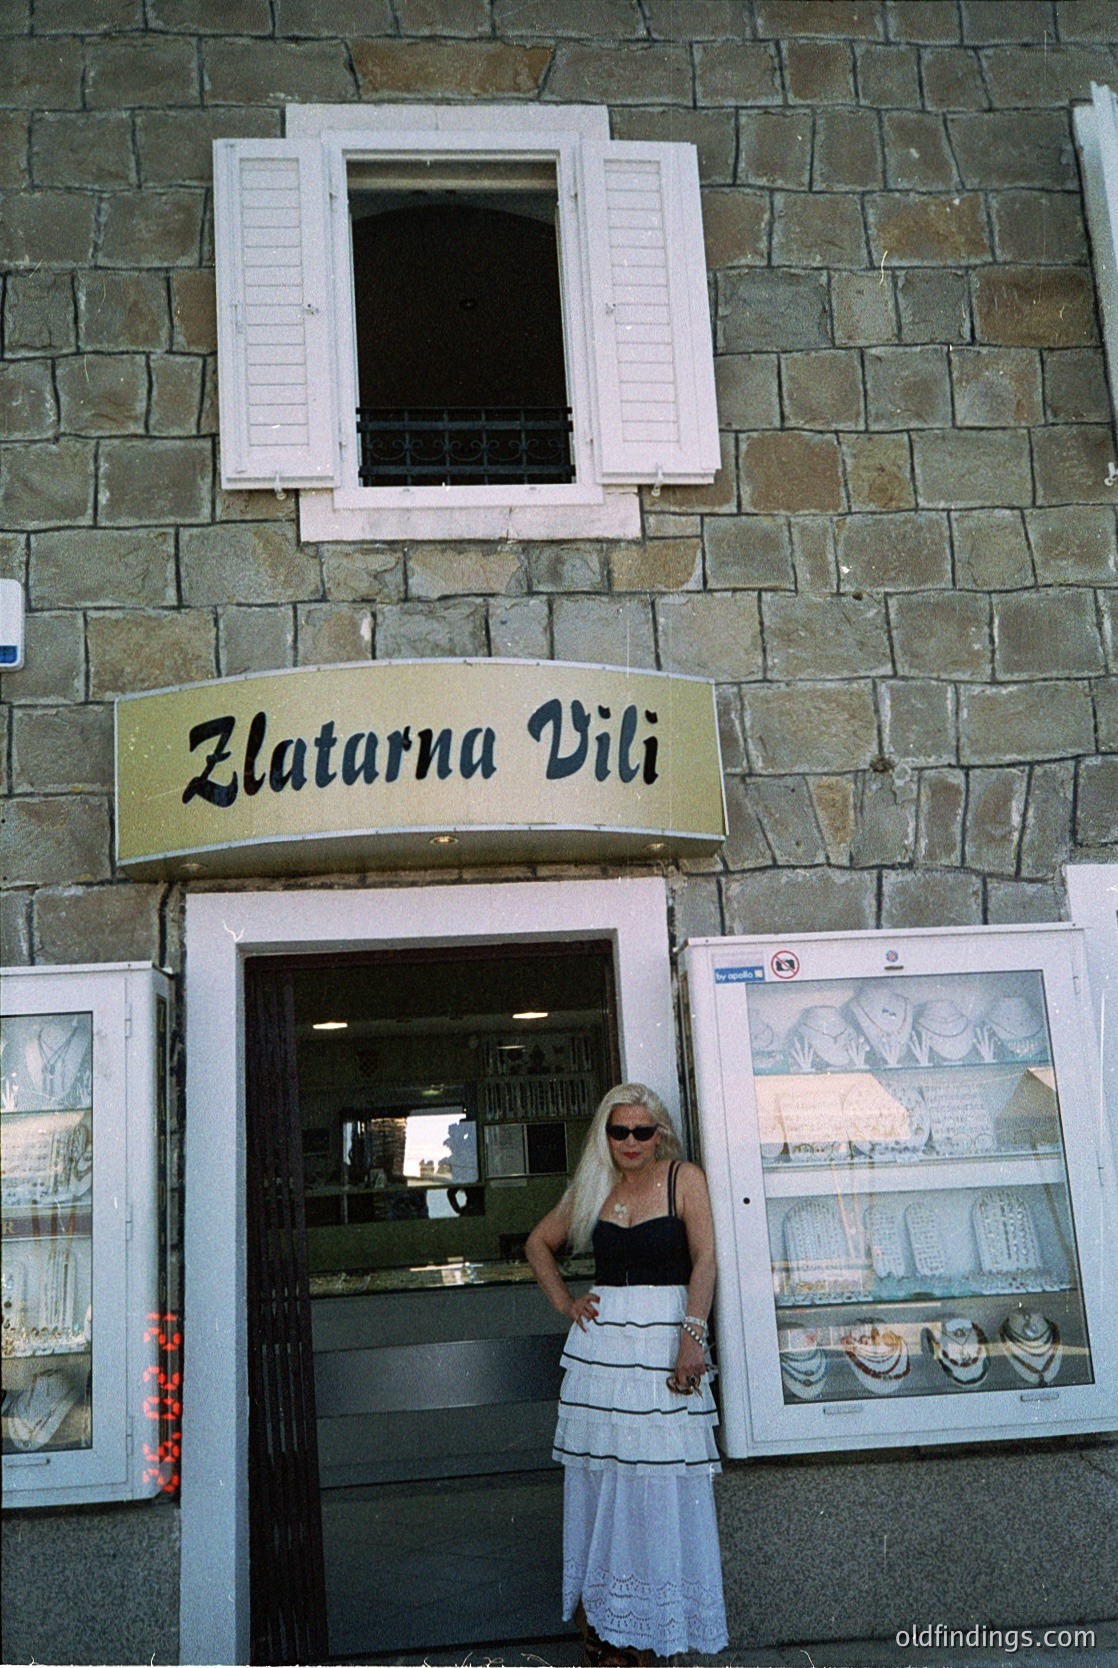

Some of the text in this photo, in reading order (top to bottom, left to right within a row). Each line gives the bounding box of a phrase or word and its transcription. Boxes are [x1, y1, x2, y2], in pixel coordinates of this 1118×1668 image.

[181, 698, 659, 808] Zlatarna Vili
[715, 970, 754, 982] by apollo
